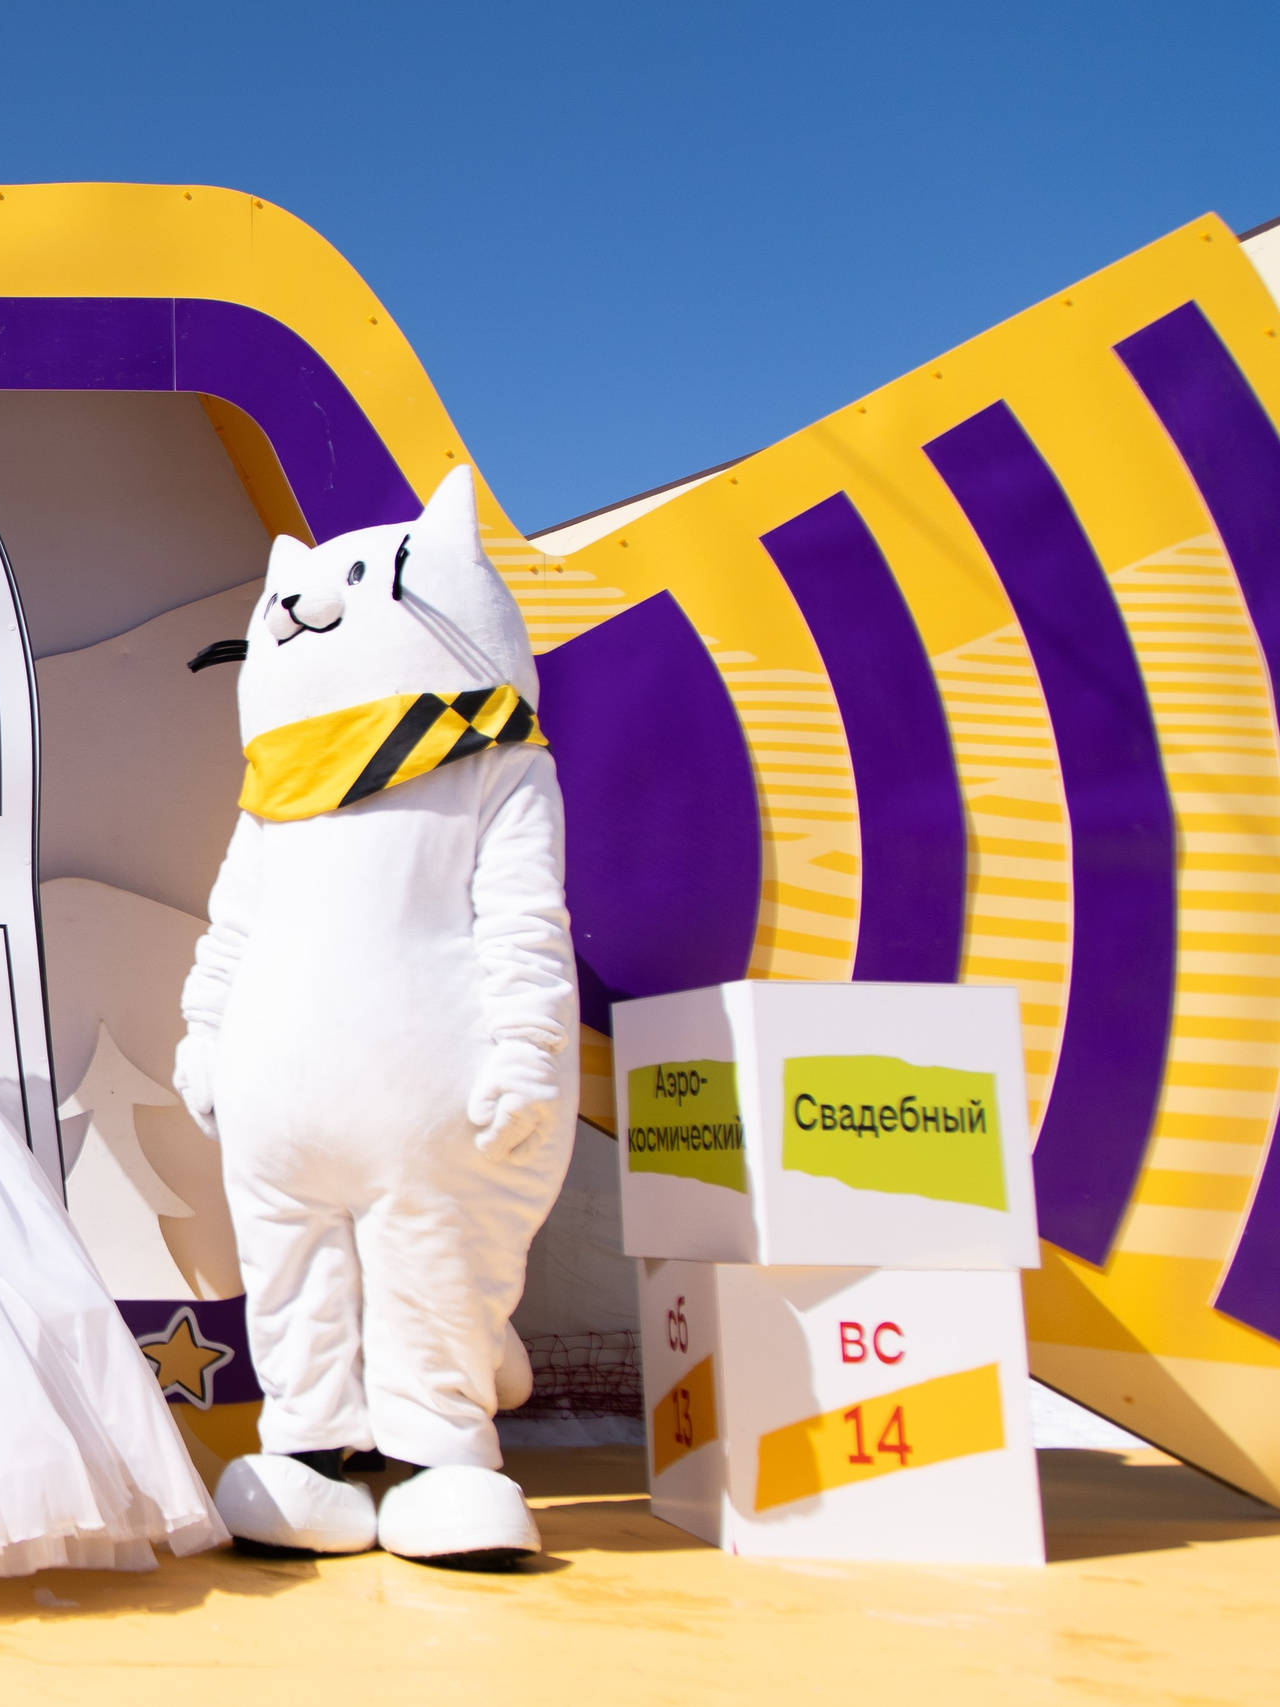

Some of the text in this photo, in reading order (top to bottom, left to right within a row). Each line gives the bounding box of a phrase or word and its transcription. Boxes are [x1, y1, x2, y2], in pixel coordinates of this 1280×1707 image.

[655, 1064, 708, 1108] Аэро-
[628, 1115, 746, 1153] космический
[794, 1093, 988, 1139] Свадебный
[673, 1388, 694, 1448] 13
[843, 1404, 914, 1467] 14
